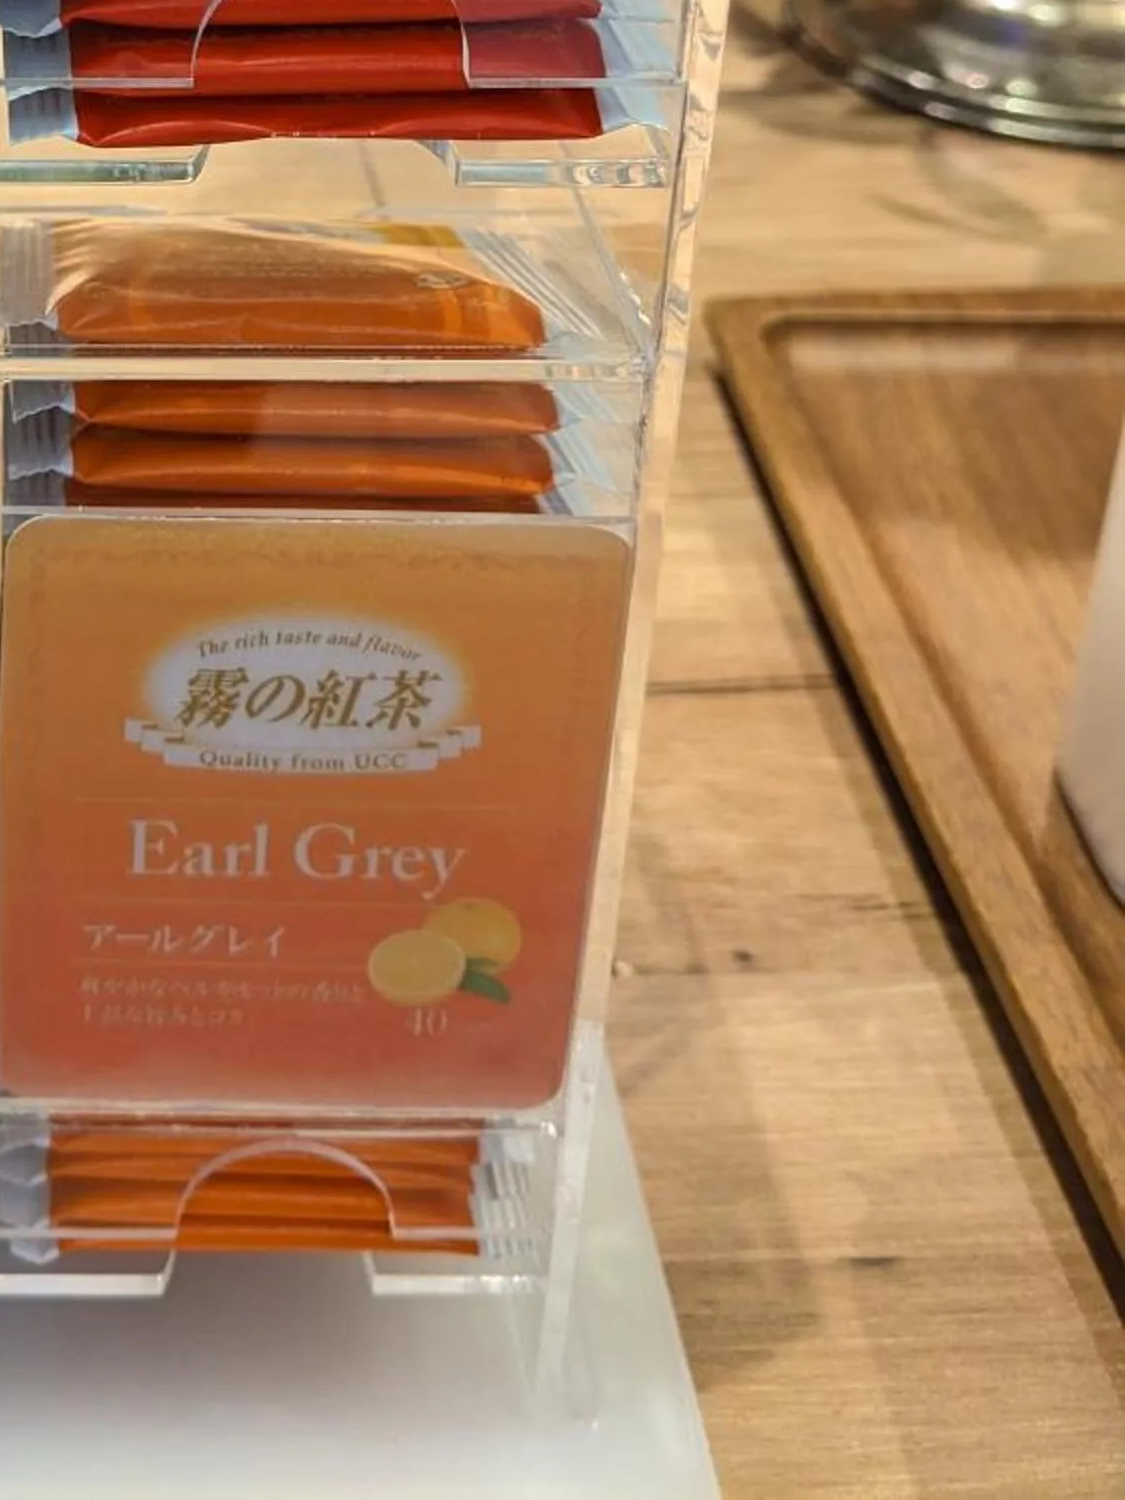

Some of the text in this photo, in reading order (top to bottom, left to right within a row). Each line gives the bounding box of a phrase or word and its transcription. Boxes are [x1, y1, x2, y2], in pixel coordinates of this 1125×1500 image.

[234, 630, 270, 652] rich
[275, 630, 322, 647] taste
[326, 631, 362, 649] and
[174, 666, 444, 731] 霧の紅茶
[199, 750, 409, 772] Quality from UCC
[128, 818, 470, 900] Earl Grey
[83, 924, 287, 959] アールグレイ
